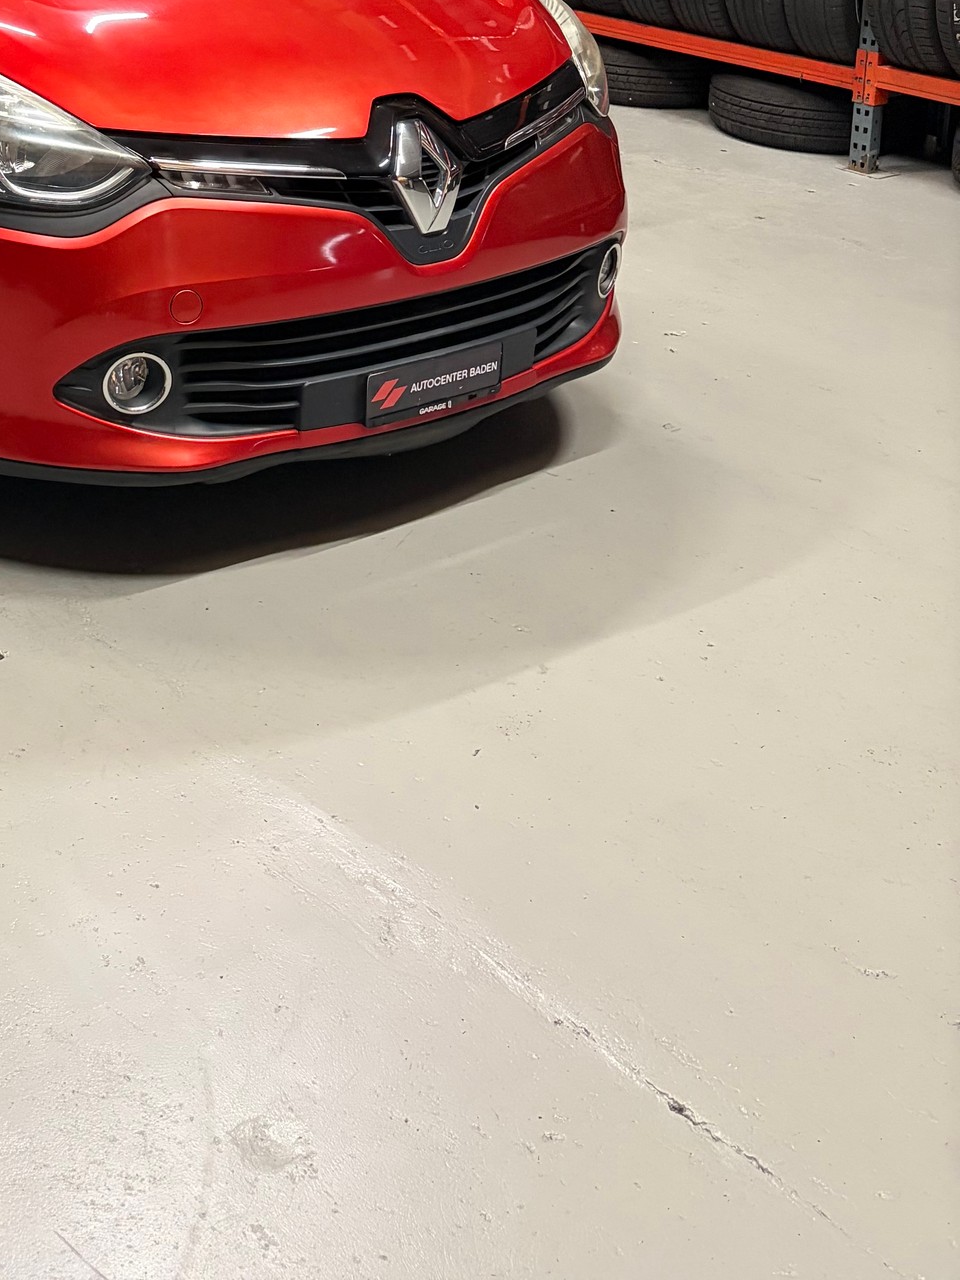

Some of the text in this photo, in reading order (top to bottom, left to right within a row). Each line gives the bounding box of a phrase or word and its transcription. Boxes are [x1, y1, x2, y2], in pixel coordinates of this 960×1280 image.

[411, 361, 497, 392] AUTOCENTER BADEN
[420, 403, 446, 414] GARAGE
